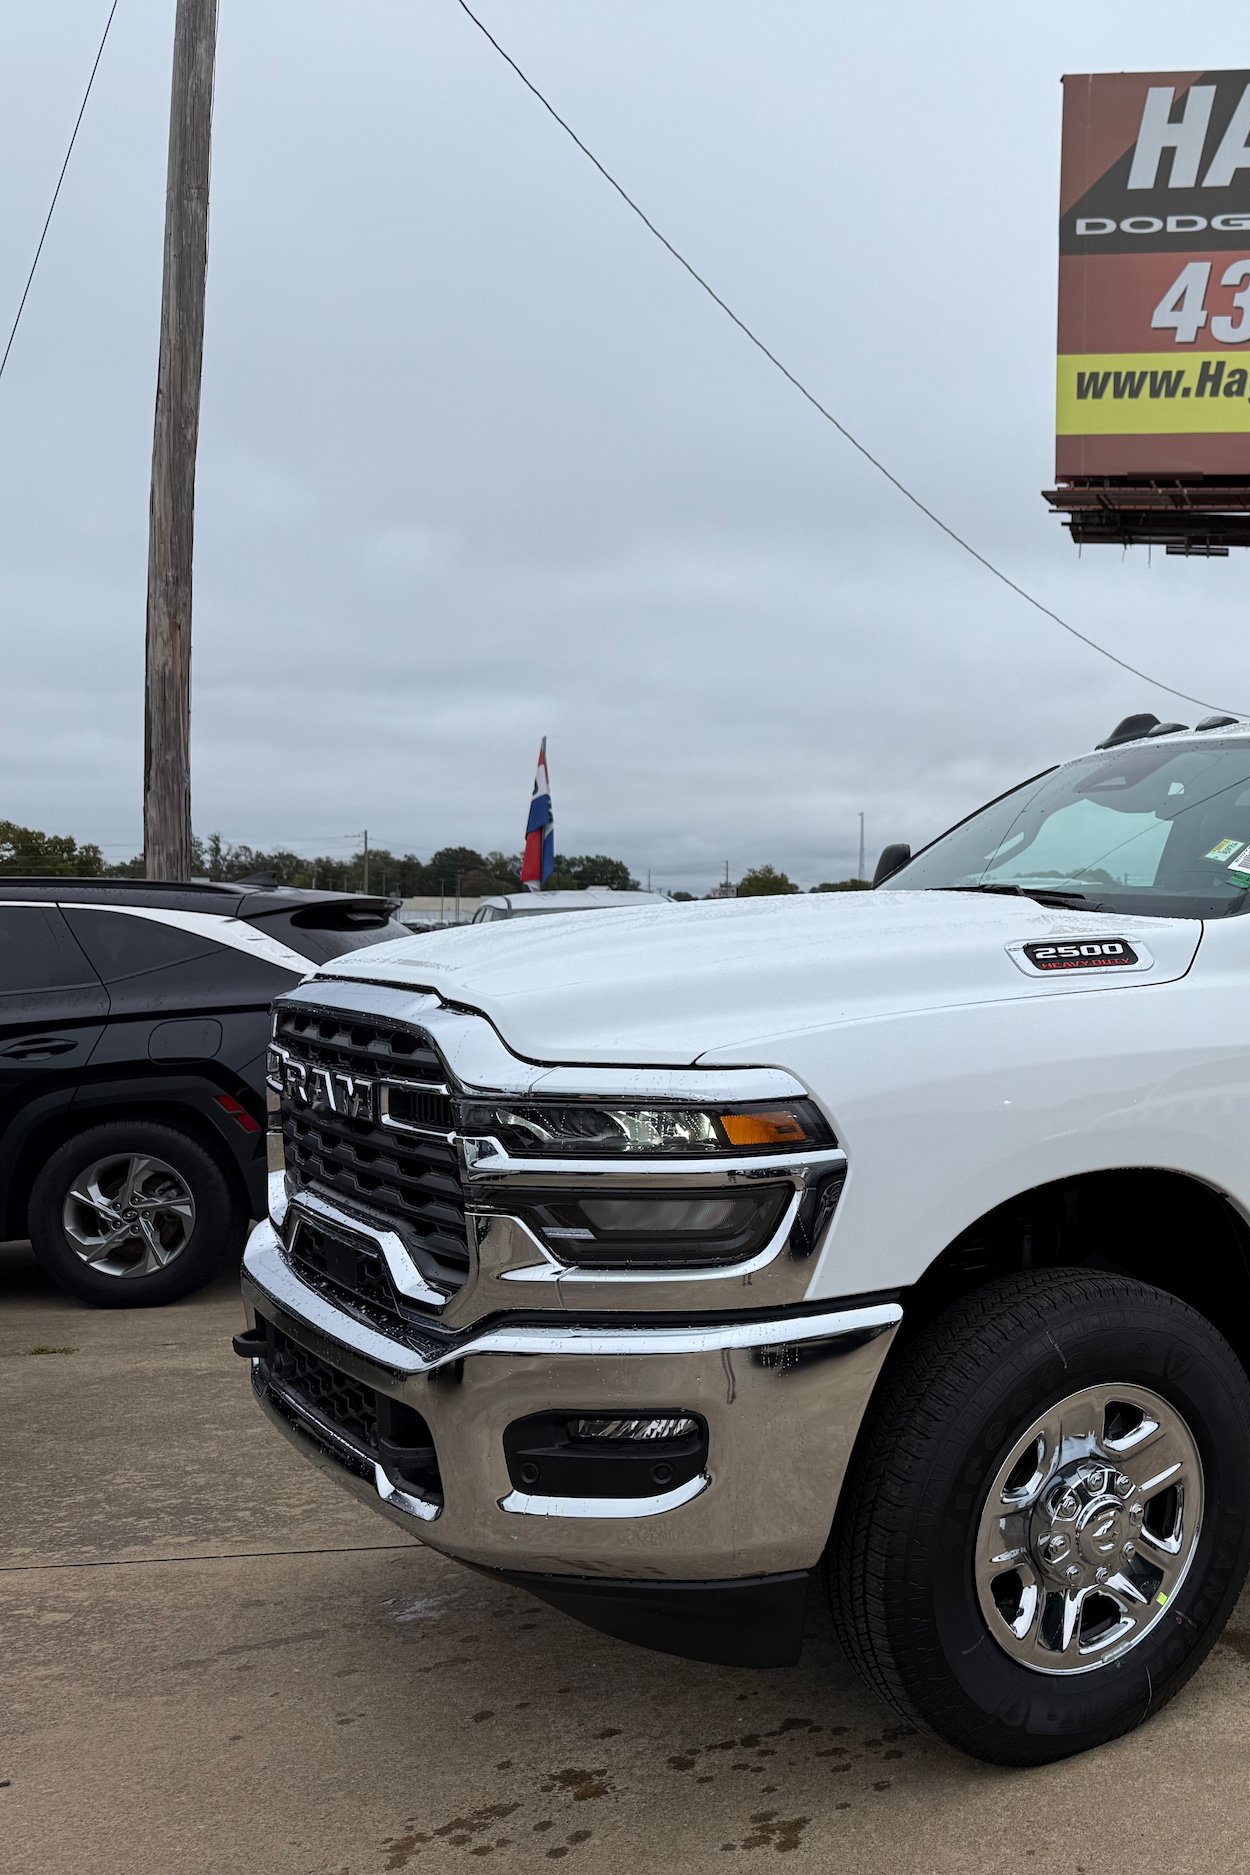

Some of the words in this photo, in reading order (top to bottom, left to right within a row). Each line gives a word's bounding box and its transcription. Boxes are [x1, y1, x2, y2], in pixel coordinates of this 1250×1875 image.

[1033, 943, 1124, 959] 2500
[1042, 960, 1089, 969] HEAVY
[1092, 958, 1129, 966] DUTY
[284, 1057, 374, 1120] RAM
